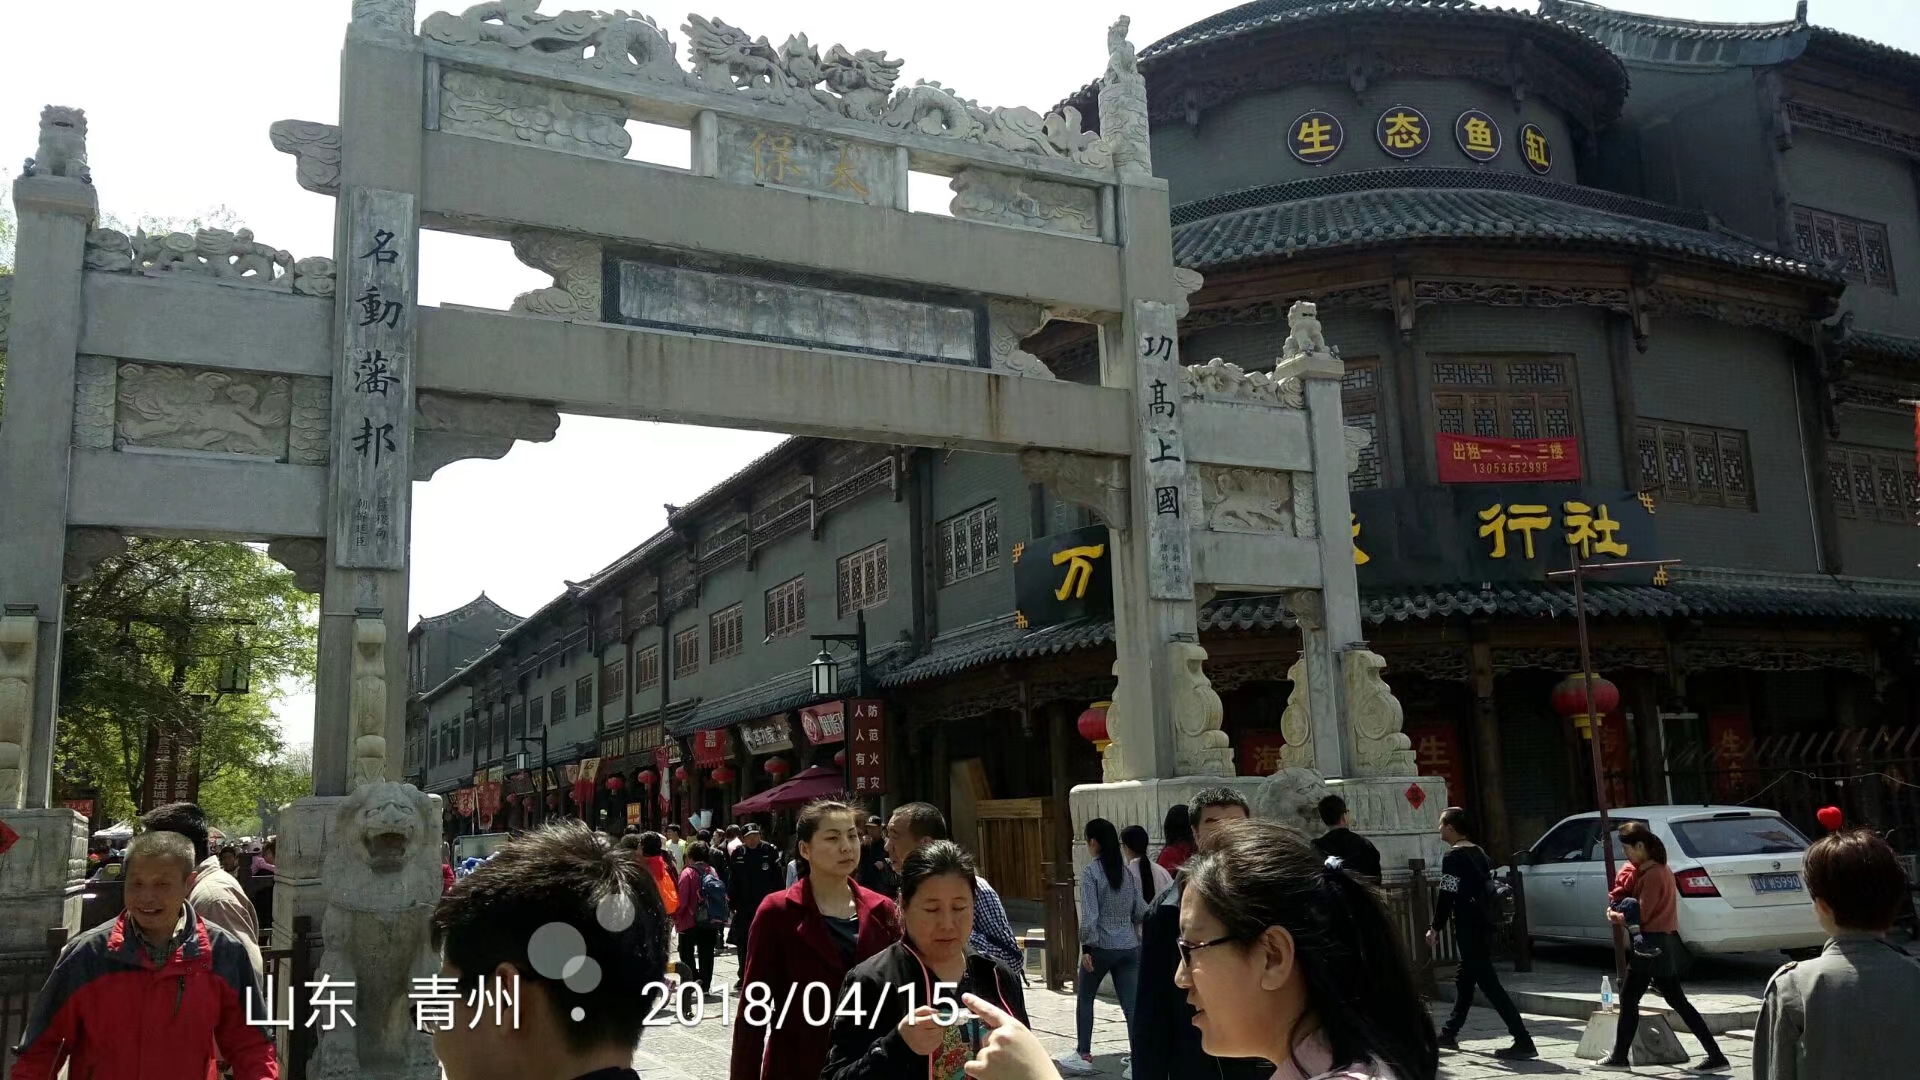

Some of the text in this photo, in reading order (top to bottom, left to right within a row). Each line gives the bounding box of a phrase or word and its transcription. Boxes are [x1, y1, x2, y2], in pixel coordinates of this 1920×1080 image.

[1297, 112, 1549, 167] 生态鱼缸
[1453, 441, 1564, 461] 出租一、二、三楼
[1472, 461, 1549, 474] 13053652999
[1052, 544, 1105, 602] 万
[854, 704, 866, 789] 人人有责
[867, 705, 880, 789] 防范火灾
